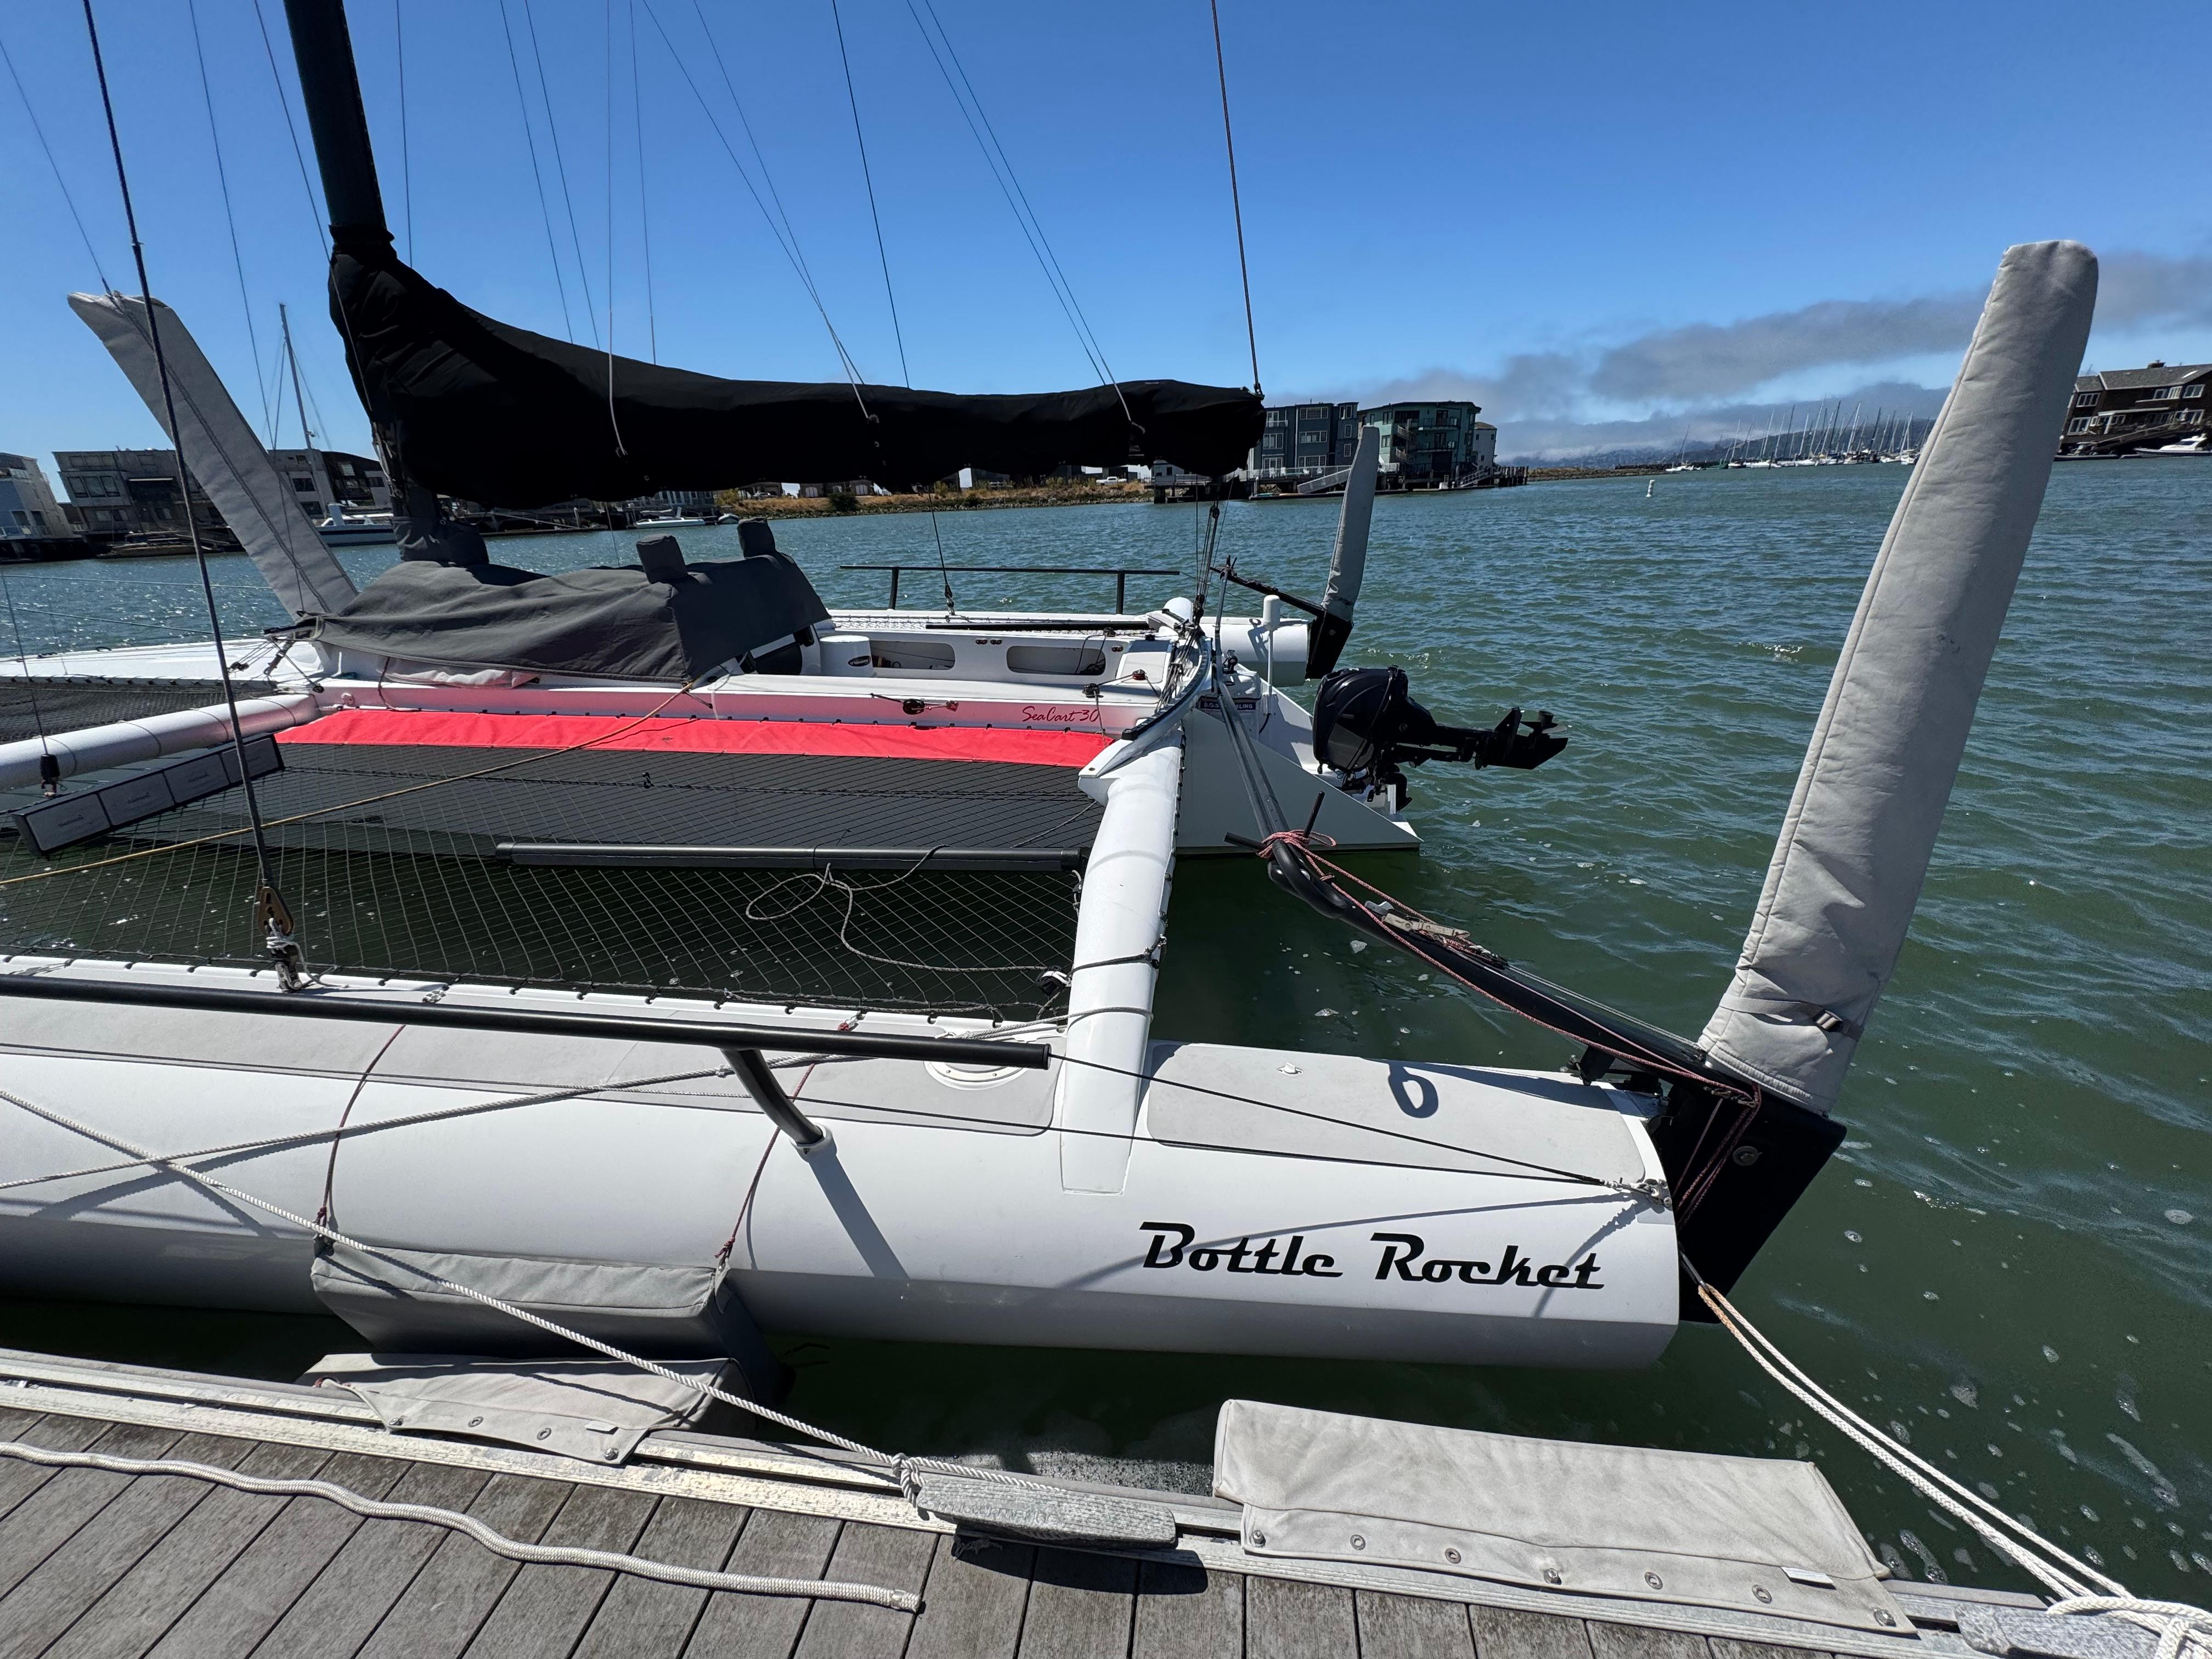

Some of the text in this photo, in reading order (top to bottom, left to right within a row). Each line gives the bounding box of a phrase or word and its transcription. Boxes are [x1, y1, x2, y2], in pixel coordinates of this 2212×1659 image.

[1080, 709, 1099, 722] 30
[1139, 1221, 1605, 1289] Bottle Rocket
